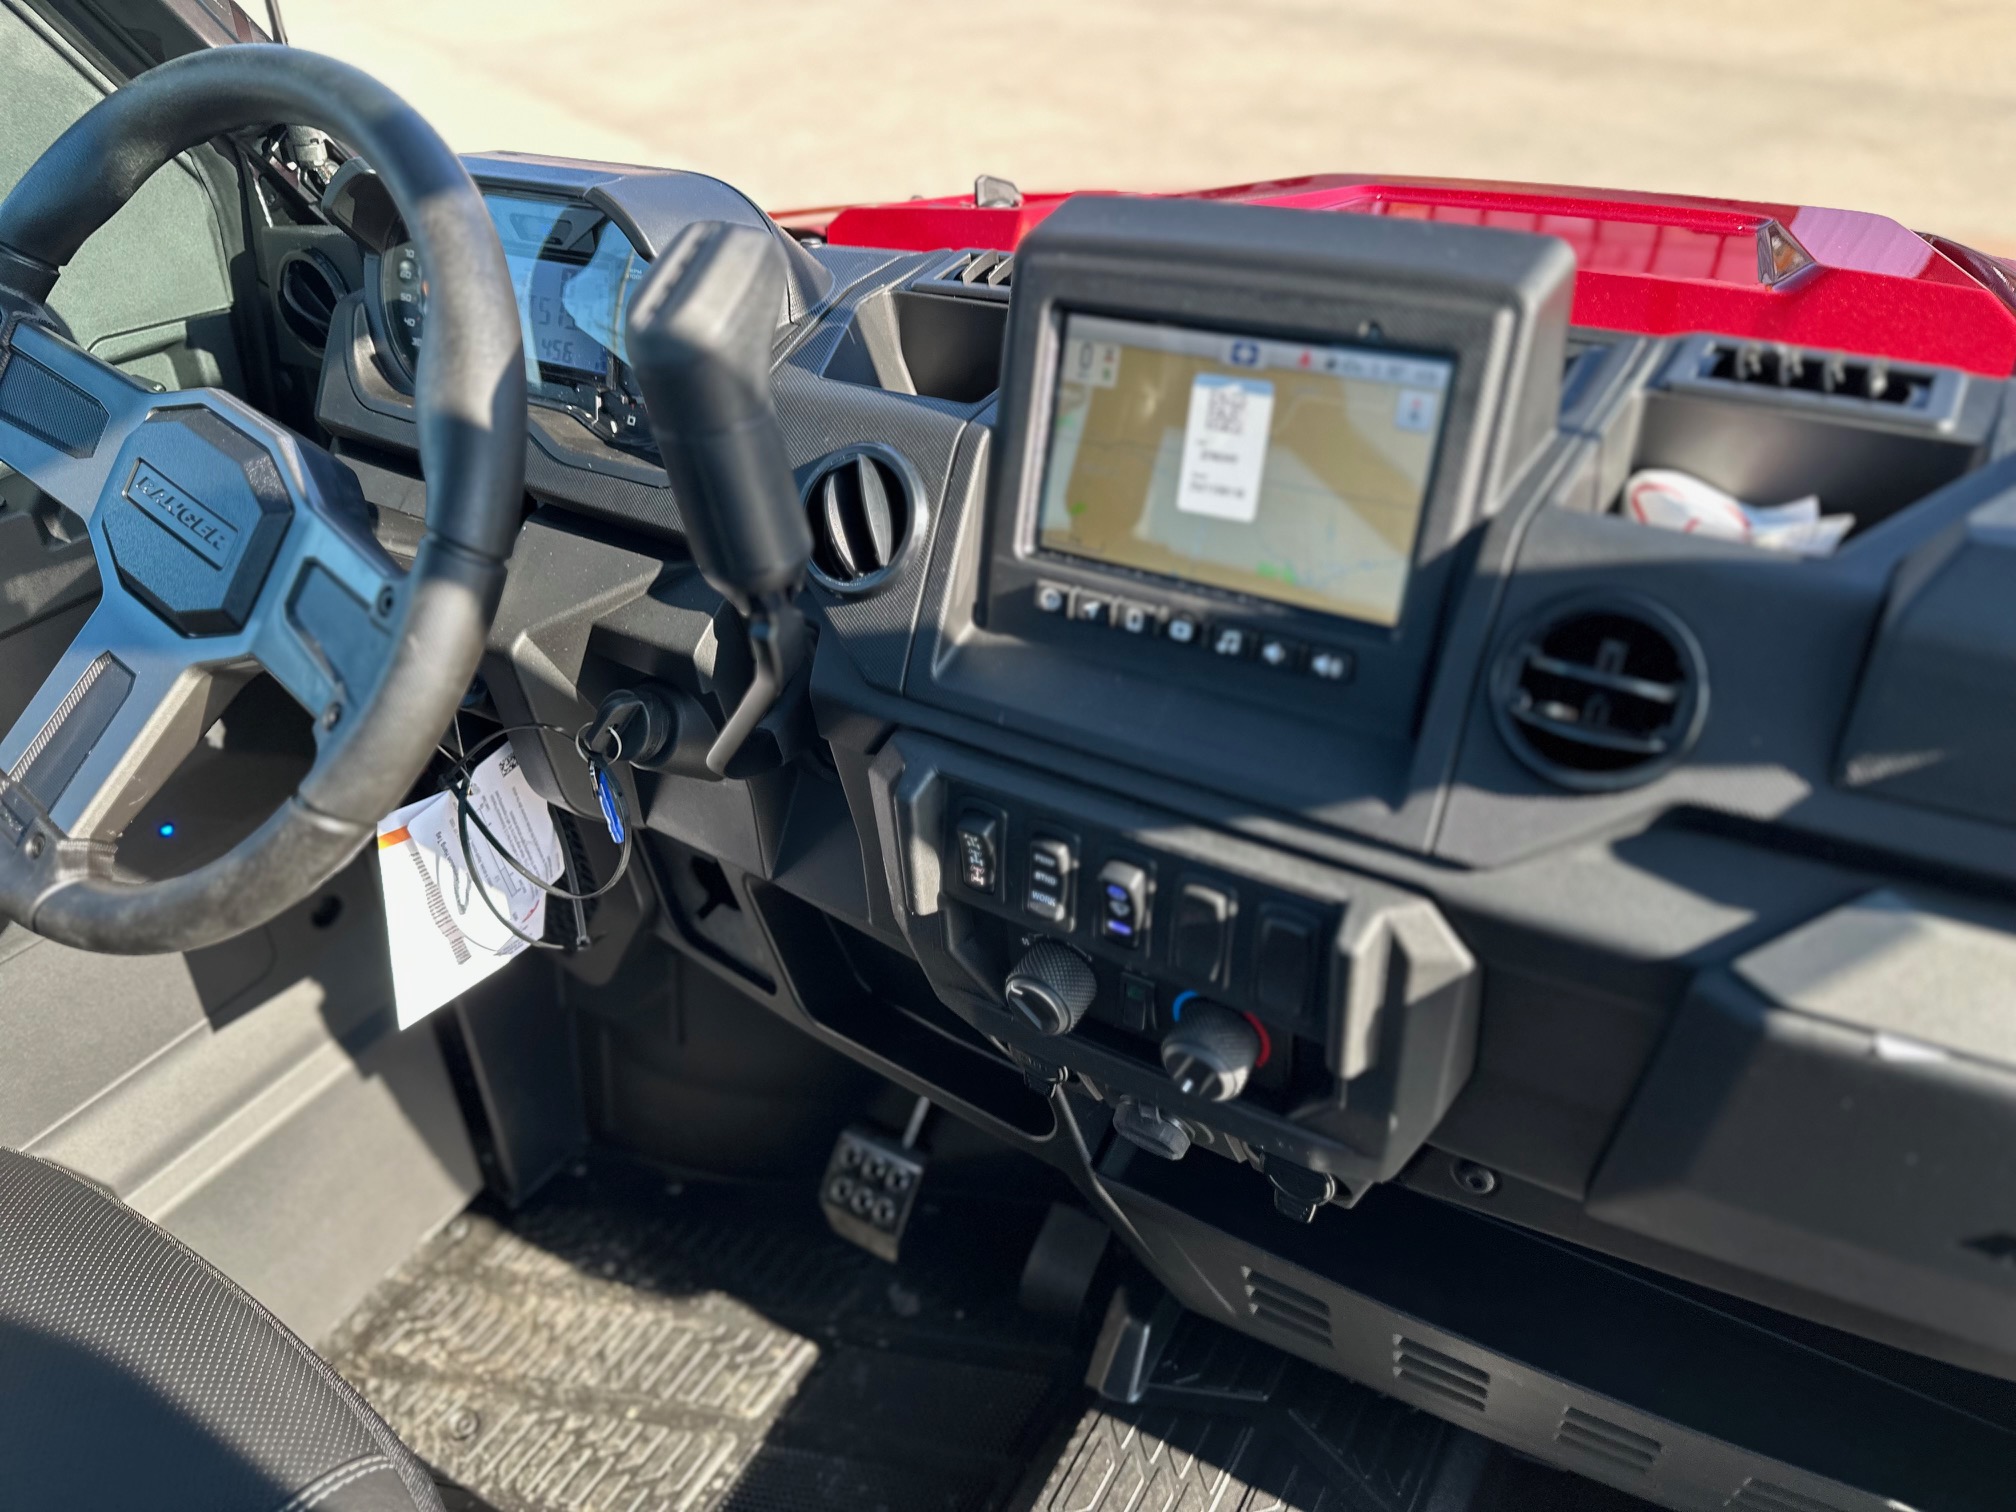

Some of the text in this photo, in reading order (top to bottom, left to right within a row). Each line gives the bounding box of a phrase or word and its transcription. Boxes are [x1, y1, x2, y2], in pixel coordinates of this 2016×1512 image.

[405, 248, 415, 259] 70
[400, 292, 412, 302] 50
[404, 317, 416, 327] 40
[135, 476, 226, 551] RANGER
[1032, 890, 1056, 907] WORK
